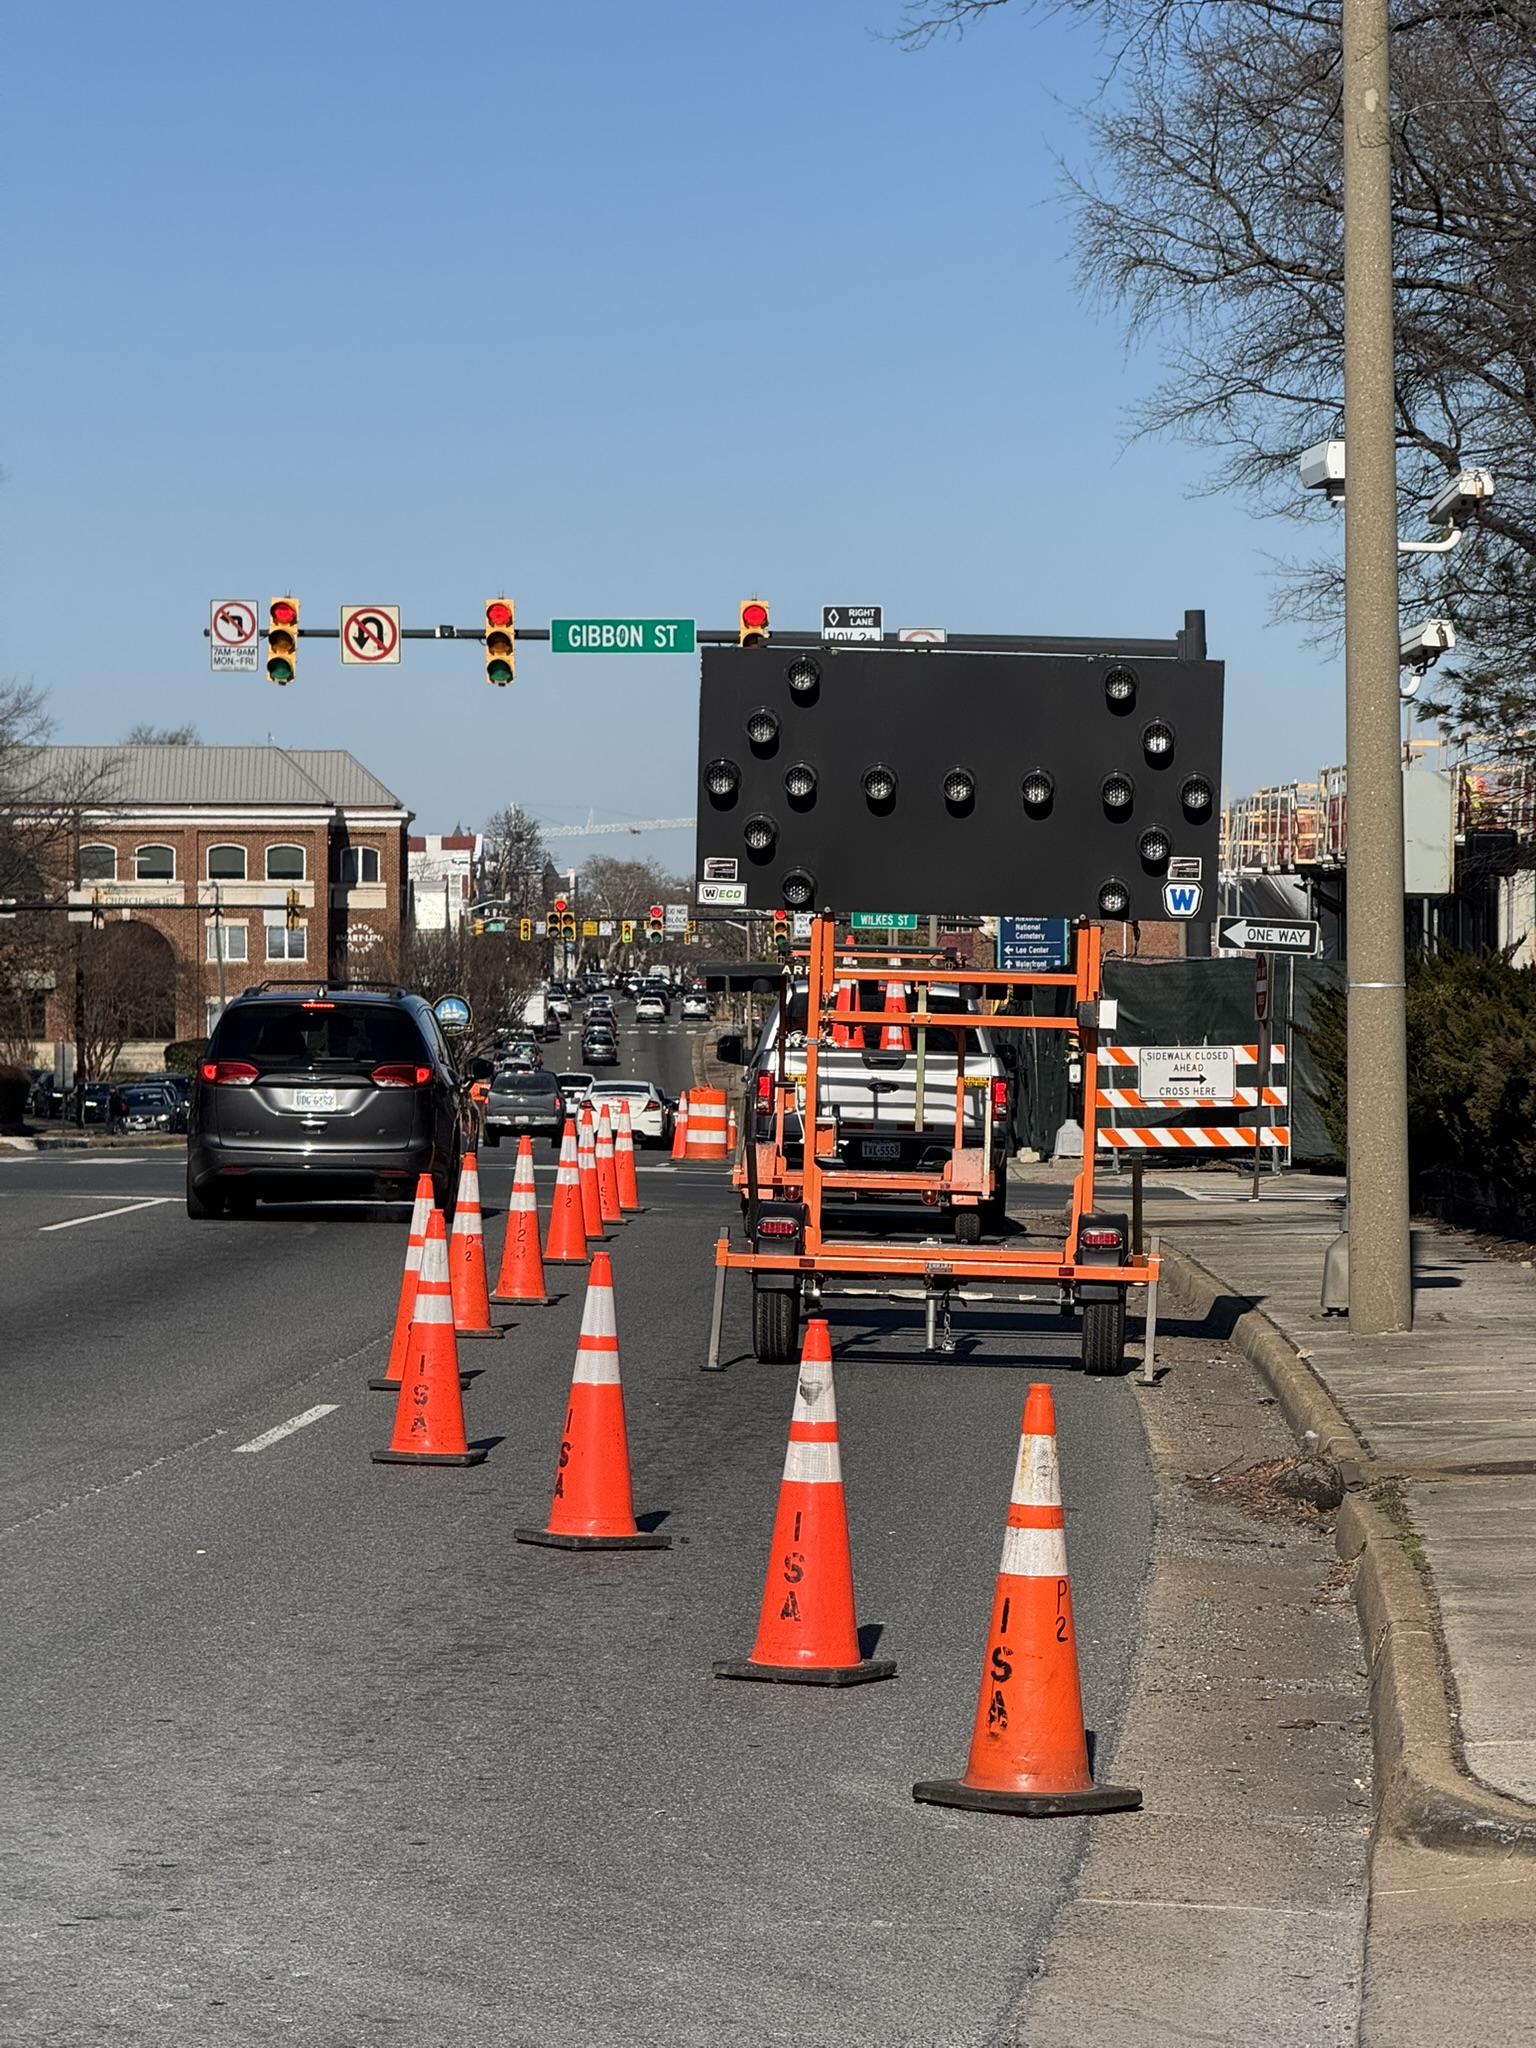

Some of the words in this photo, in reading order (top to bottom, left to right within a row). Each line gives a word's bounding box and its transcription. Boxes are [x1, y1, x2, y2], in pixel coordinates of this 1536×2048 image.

[848, 608, 876, 617] RIGHT
[850, 617, 874, 626] LANE
[568, 624, 643, 648] GIBBON
[654, 624, 678, 648] ST
[213, 648, 256, 656] 7AM-9AM
[1170, 888, 1196, 911] W
[861, 914, 894, 926] WILKES
[898, 915, 910, 926] ST
[1015, 923, 1042, 931] National
[1015, 932, 1046, 941] Cemetery
[1247, 928, 1274, 942] ONE
[1278, 930, 1307, 943] WAY
[1015, 946, 1028, 954] Lee
[1028, 946, 1050, 954] Center
[1146, 1052, 1192, 1061] SIDEWALK
[1195, 1052, 1229, 1061] CLOSED
[1173, 1063, 1204, 1073] AHEAD
[1159, 1087, 1190, 1096] CROSS
[1193, 1087, 1217, 1096] HERE
[780, 1511, 805, 1622] ISA
